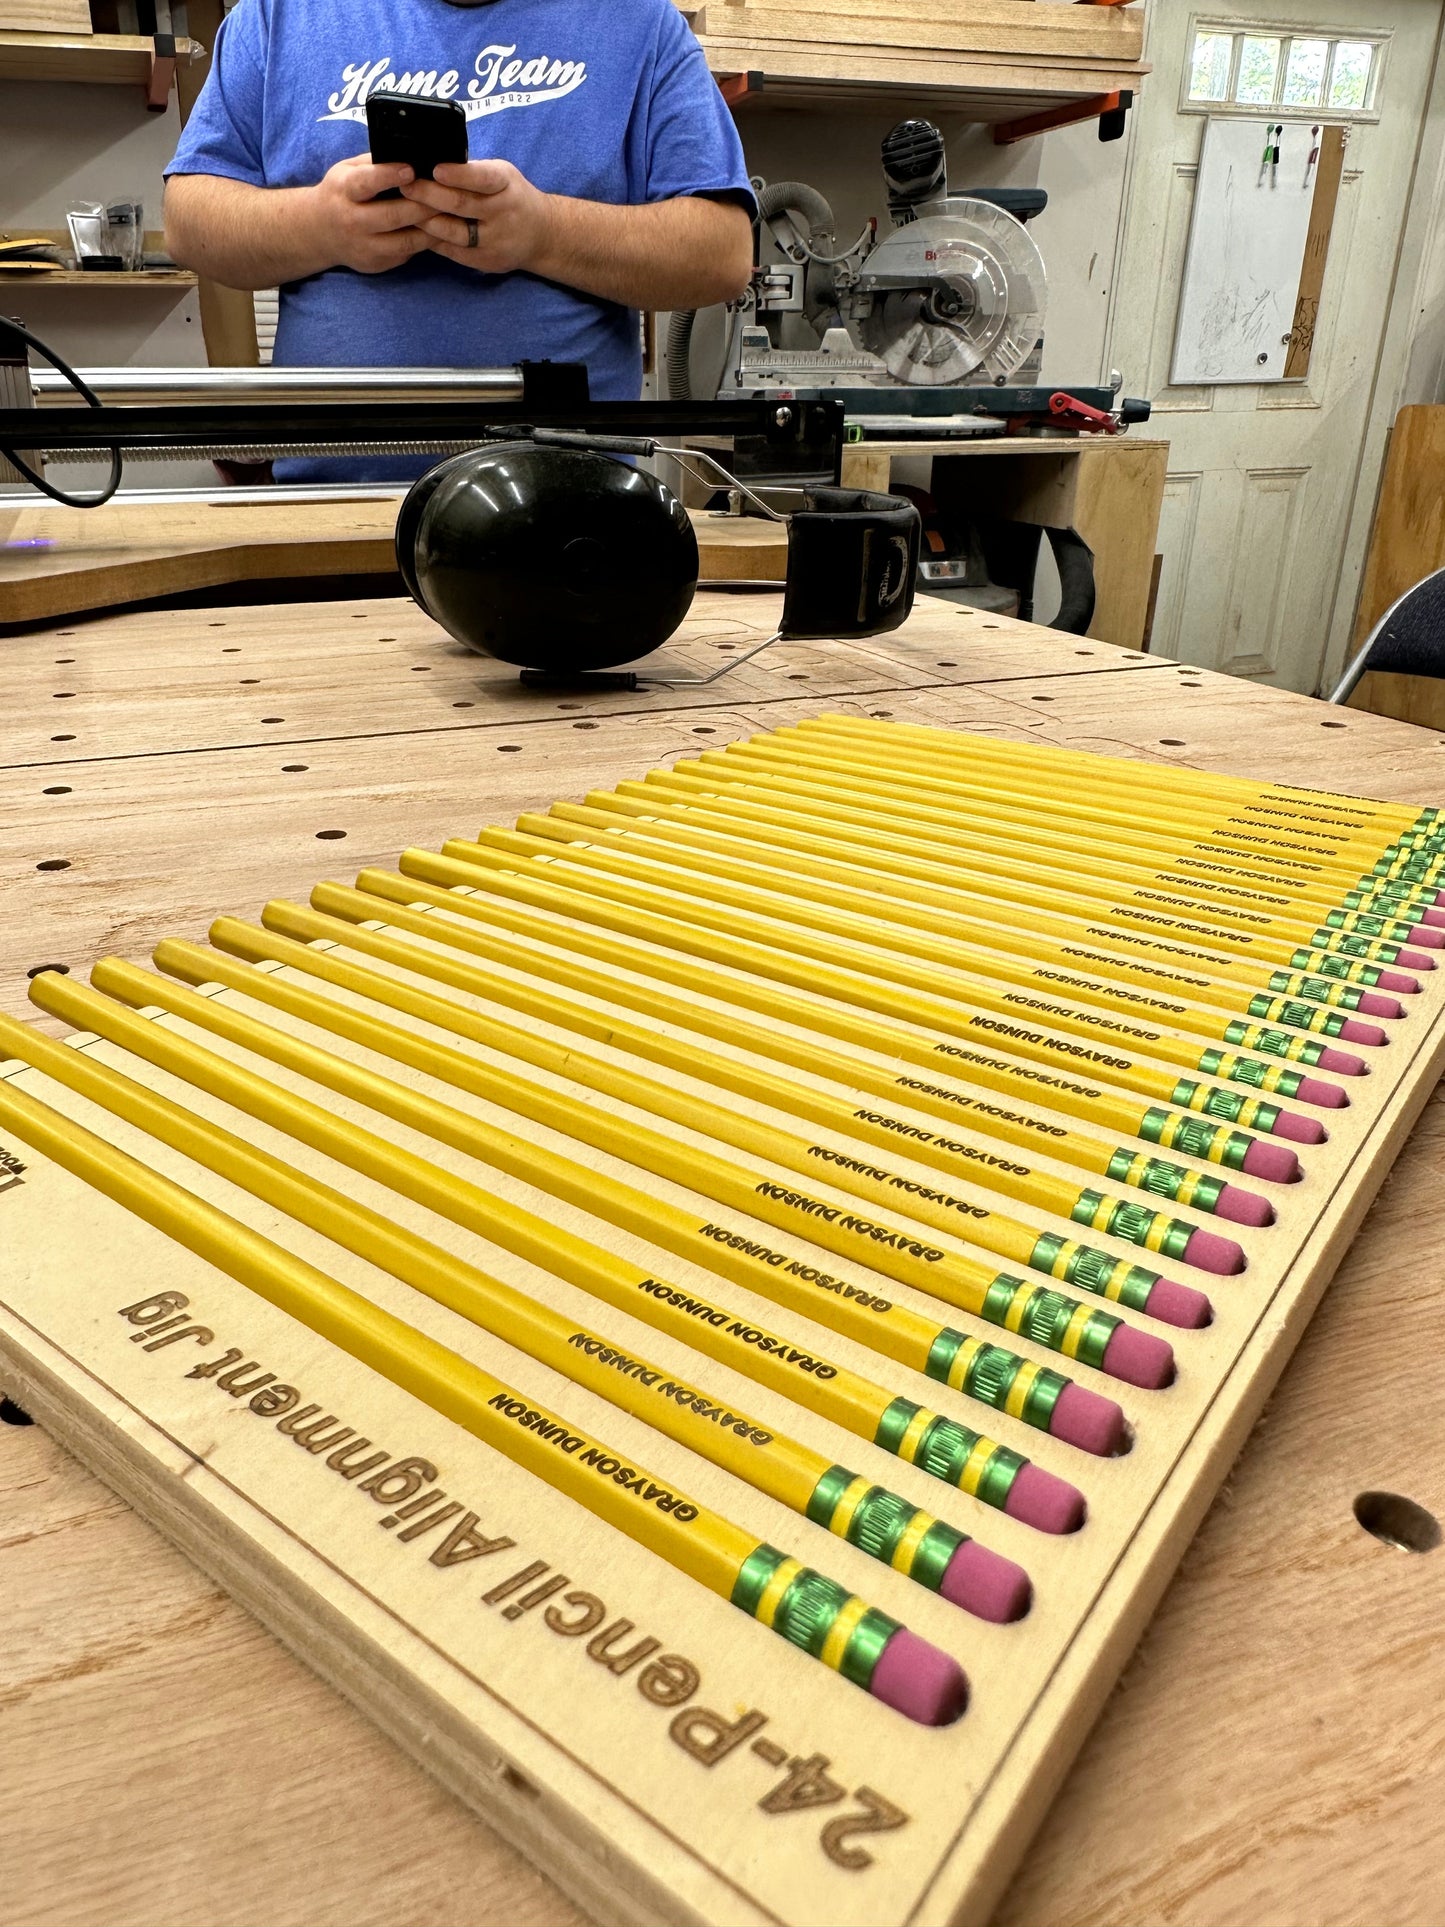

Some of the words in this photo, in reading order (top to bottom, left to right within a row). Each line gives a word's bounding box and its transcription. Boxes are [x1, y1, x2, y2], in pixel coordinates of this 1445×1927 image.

[327, 57, 460, 112] Home
[467, 44, 588, 99] Team
[500, 93, 532, 104] 2022
[1175, 858, 1236, 873] DUNSON
[1236, 870, 1307, 887] GRAYSON
[1155, 874, 1217, 890] DUNSON
[1217, 887, 1291, 905] GRAYSON
[1133, 890, 1197, 908] DUNSON
[1197, 904, 1272, 924] GRAYSON
[1110, 908, 1175, 926] DUNSON
[1176, 923, 1253, 943] GRAYSON
[1086, 927, 1152, 946] DUNSON
[1060, 947, 1128, 967] DUNSON
[1152, 943, 1232, 965] GRAYSON
[1032, 969, 1103, 990] DUNSON
[1129, 963, 1211, 987] GRAYSON
[1002, 993, 1075, 1015] DUNSON
[1103, 987, 1186, 1014] GRAYSON
[969, 1016, 1044, 1043] DUNSON
[1074, 1012, 1160, 1042] GRAYSON
[934, 1043, 1010, 1070] DUNSON
[1043, 1038, 1132, 1070] GRAYSON
[895, 1076, 975, 1105] DUNSON
[1009, 1066, 1102, 1099] GRAYSON
[854, 1110, 934, 1142] DUNSON
[972, 1102, 1067, 1137] GRAYSON
[808, 1146, 891, 1181] DUNSON
[933, 1138, 1031, 1176] GRAYSON
[756, 1182, 841, 1221] DUNSON
[889, 1177, 990, 1219] GRAYSON
[699, 1223, 786, 1267] DUNSON
[839, 1216, 945, 1262] GRAYSON
[638, 1278, 730, 1327] DUNSON
[784, 1262, 892, 1312] GRAYSON
[117, 1290, 215, 1352] Jig
[568, 1333, 661, 1386] DUNSON
[726, 1321, 838, 1380] GRAYSON
[488, 1393, 585, 1454] DUNSON
[657, 1380, 774, 1446] GRAYSON
[183, 1347, 517, 1568] Alignment
[579, 1448, 699, 1523] GRAYSON
[480, 1559, 911, 1872] 24-Pencil
